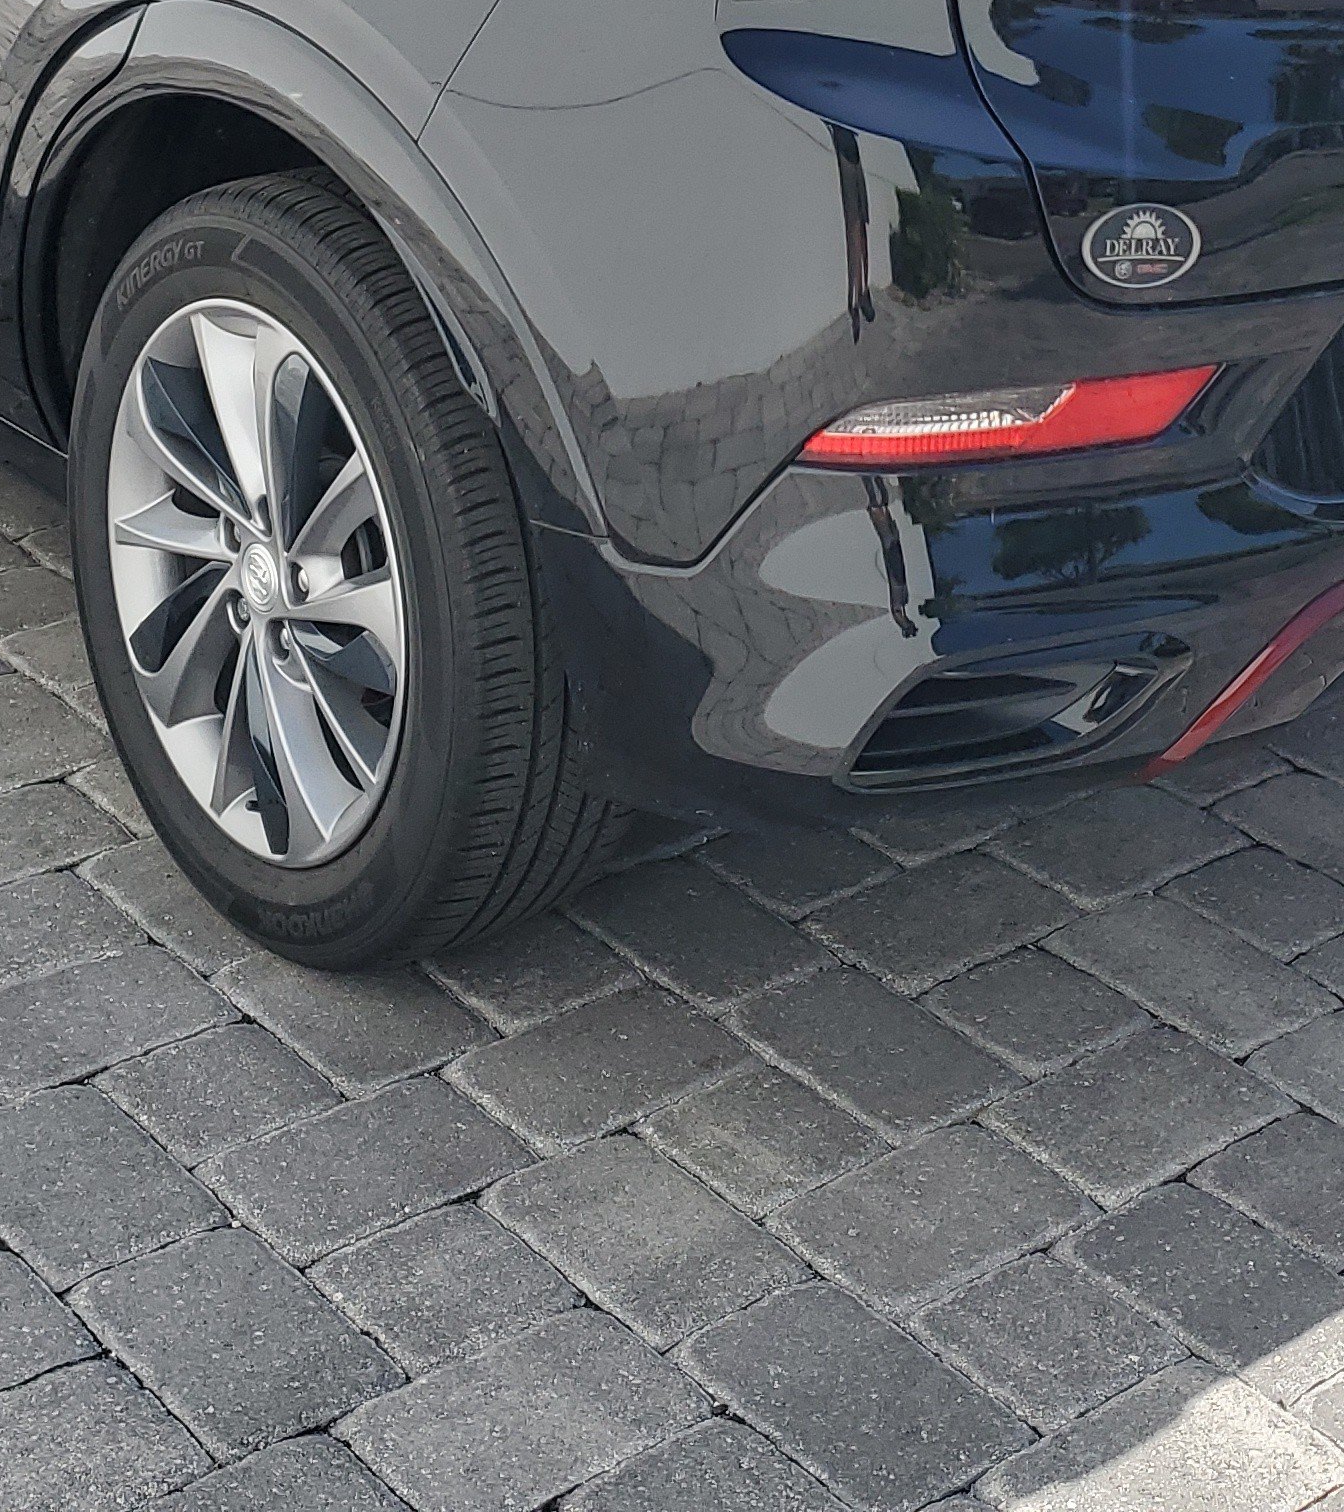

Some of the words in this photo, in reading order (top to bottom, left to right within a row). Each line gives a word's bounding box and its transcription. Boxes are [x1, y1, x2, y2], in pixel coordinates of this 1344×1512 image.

[1105, 237, 1180, 256] DELRAY
[117, 238, 184, 310] KINERGY
[184, 240, 206, 260] GT
